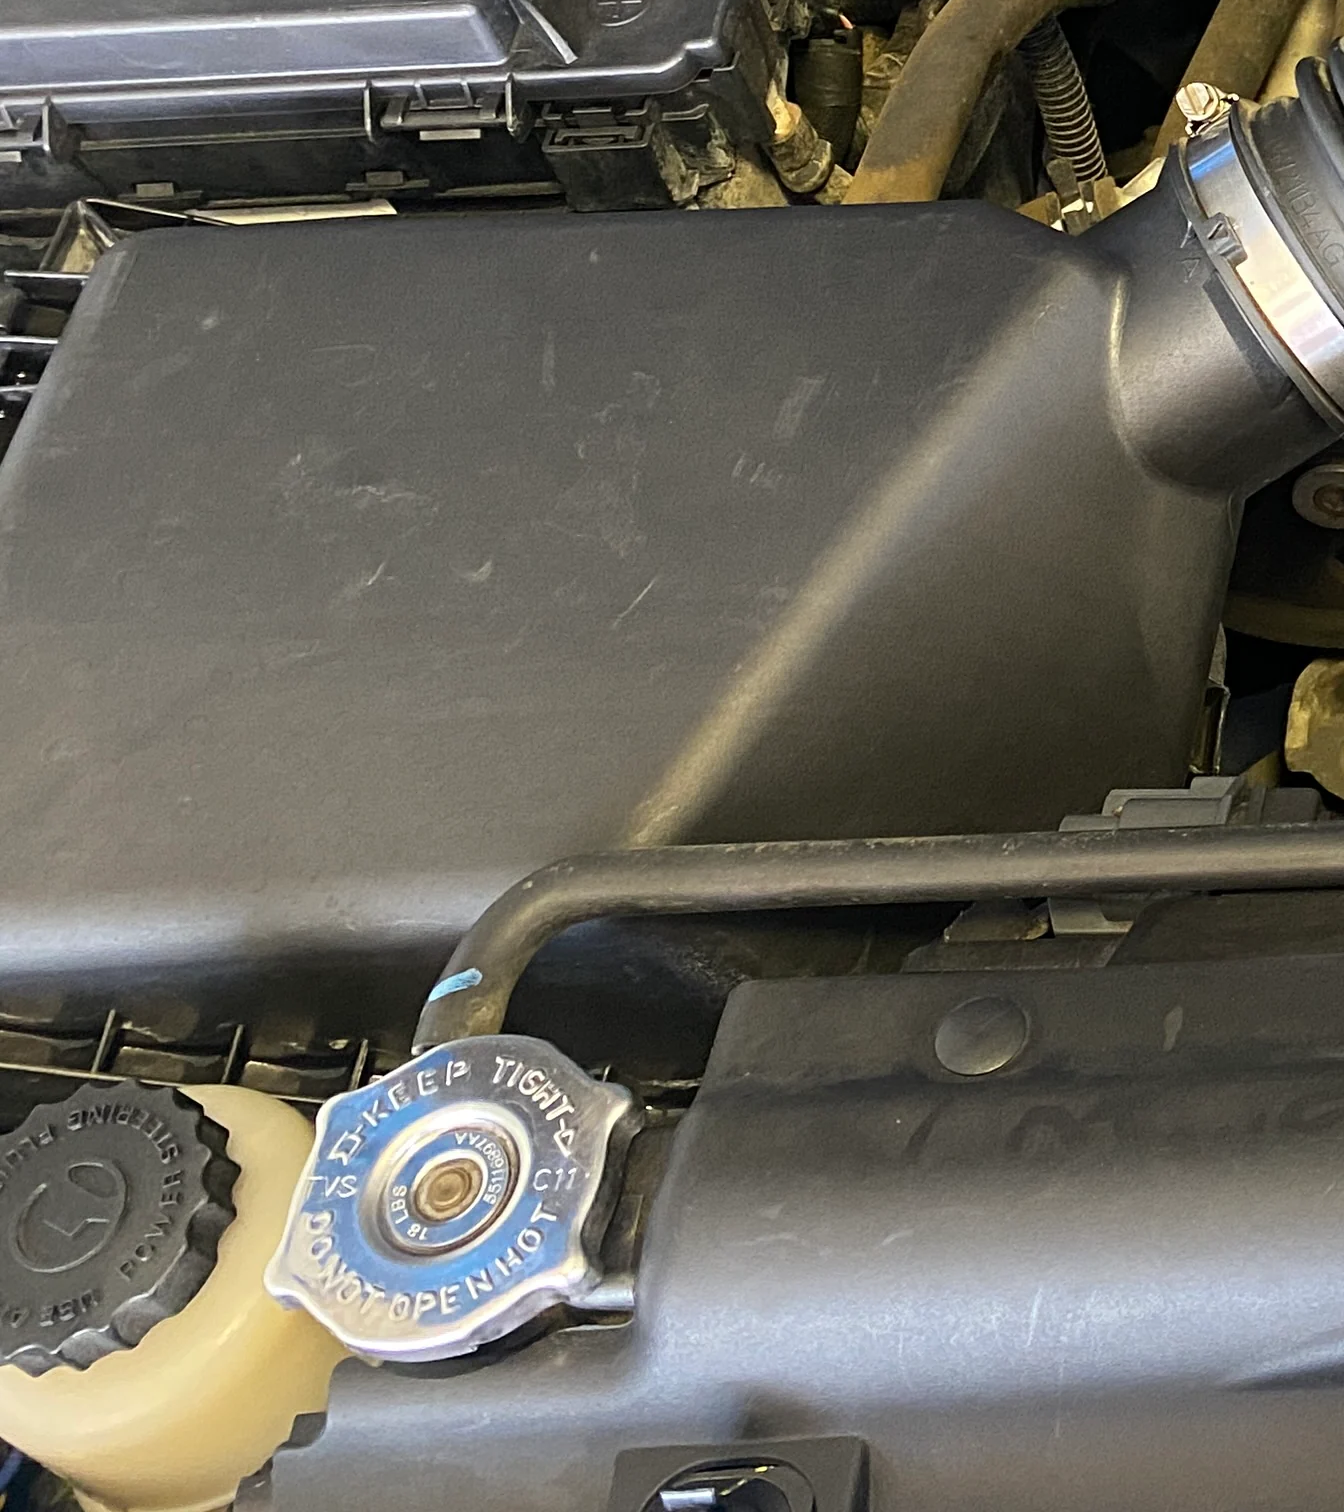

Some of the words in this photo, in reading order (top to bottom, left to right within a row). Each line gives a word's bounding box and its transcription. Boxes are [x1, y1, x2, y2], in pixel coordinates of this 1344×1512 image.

[363, 1060, 470, 1127] KEEP
[491, 1056, 575, 1122] TIGHT
[391, 1184, 409, 1224] LBS
[406, 1222, 428, 1240] 18
[318, 1257, 387, 1315] NOT
[388, 1272, 494, 1323] OPEN
[495, 1201, 559, 1278] HOT
